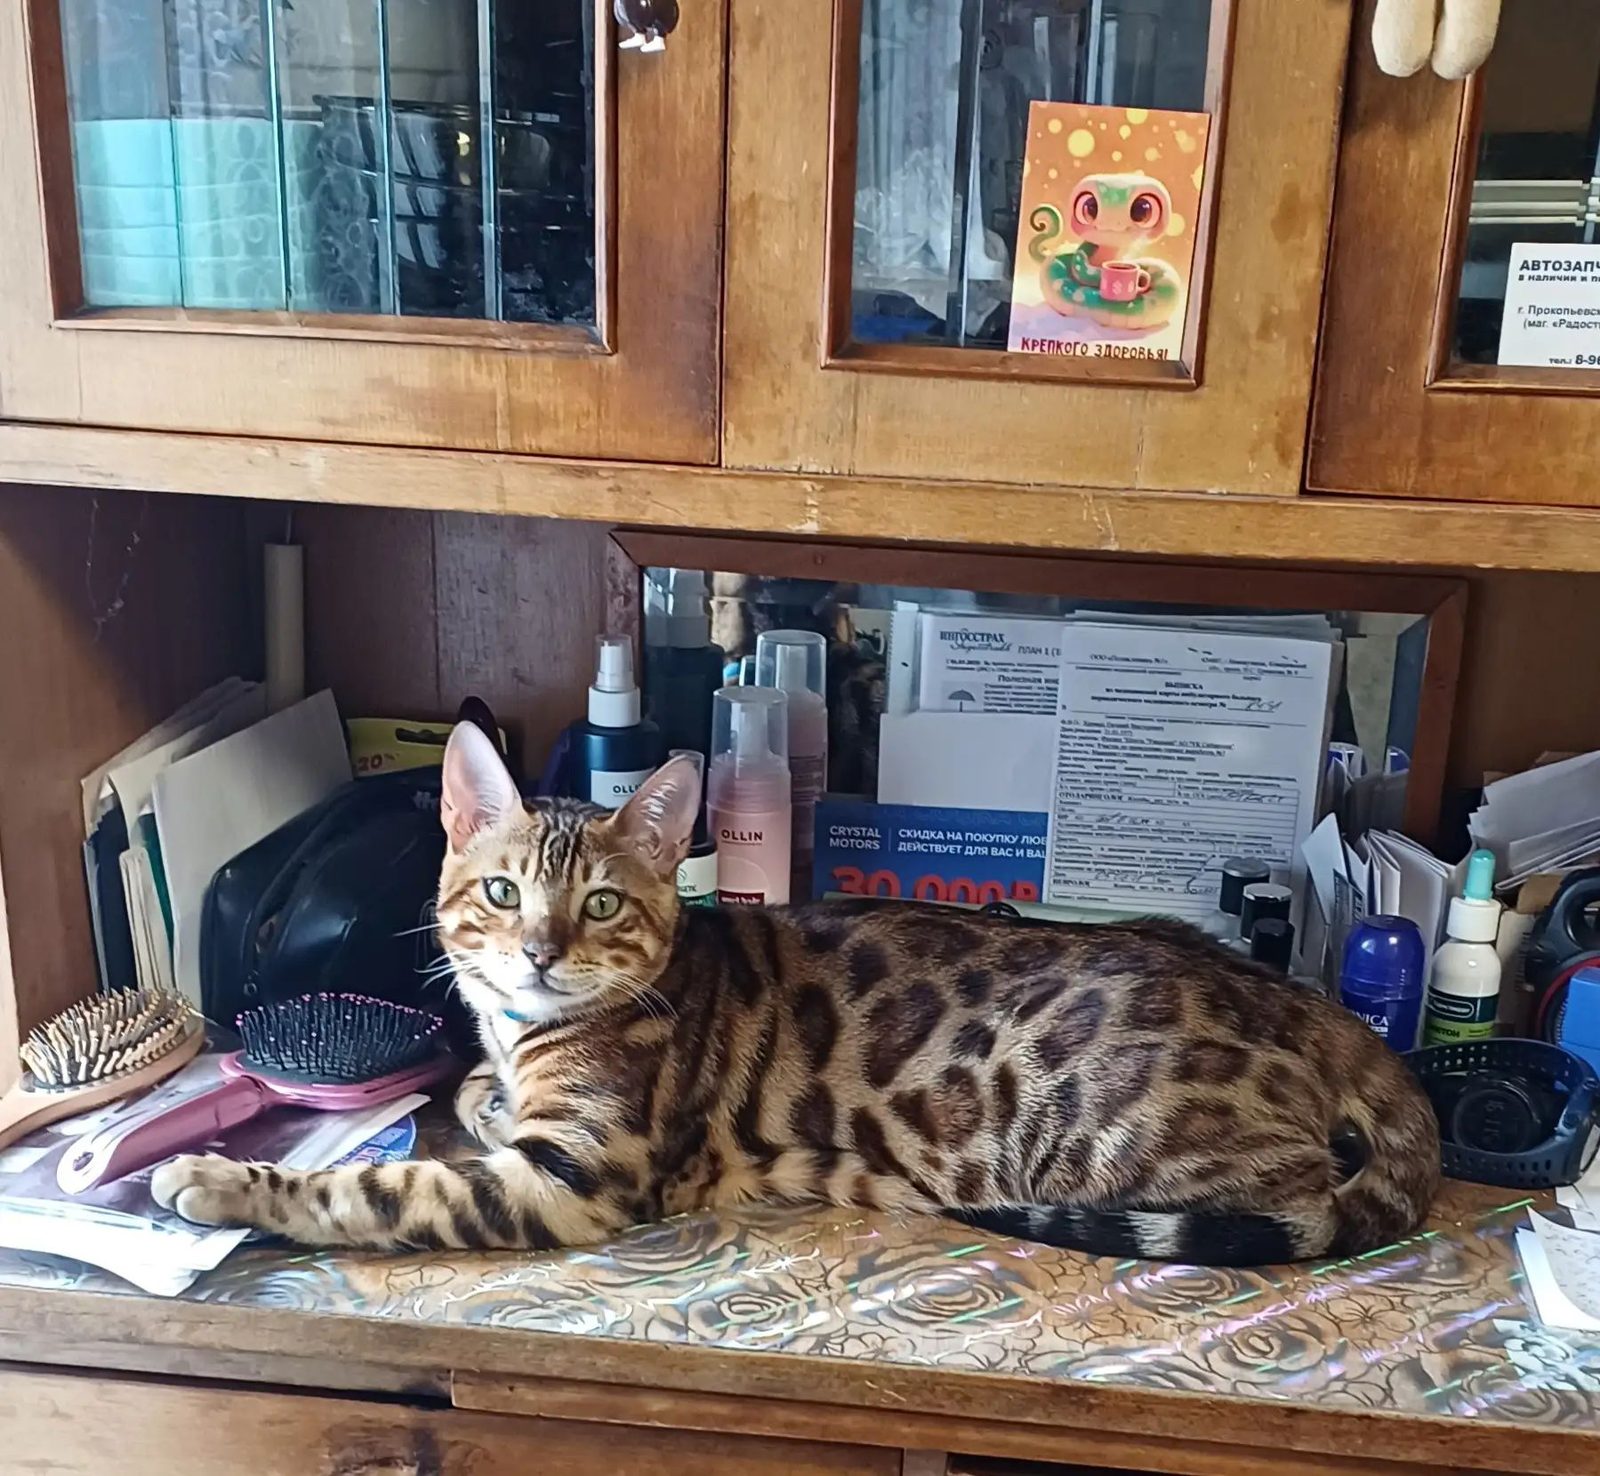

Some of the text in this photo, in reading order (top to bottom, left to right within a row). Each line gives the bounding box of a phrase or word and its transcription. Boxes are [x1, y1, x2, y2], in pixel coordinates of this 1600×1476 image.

[1518, 306, 1524, 314] г.
[1523, 318, 1600, 330] (маг. «Радост
[1021, 337, 1169, 360] КРЕПКОГО ЗДОРОВЬЯ!
[940, 629, 1005, 643] ИНГОССТРАХ
[1018, 646, 1042, 655] ПЛАН
[613, 783, 641, 794] OLLI
[721, 829, 763, 842] OLLIN
[829, 825, 881, 838] CRYSTAL
[898, 828, 945, 840] СКИДКА
[946, 831, 963, 841] НА
[965, 832, 1019, 845] ПОКУПКУ
[829, 837, 880, 850] MOTORS
[898, 841, 962, 854] ДЕЙСТВУЕТ
[964, 845, 988, 856] ДЛЯ
[991, 847, 1013, 857] ВАС
[1015, 848, 1024, 857] И
[832, 866, 901, 899] 30
[1352, 1010, 1389, 1027] NICA
